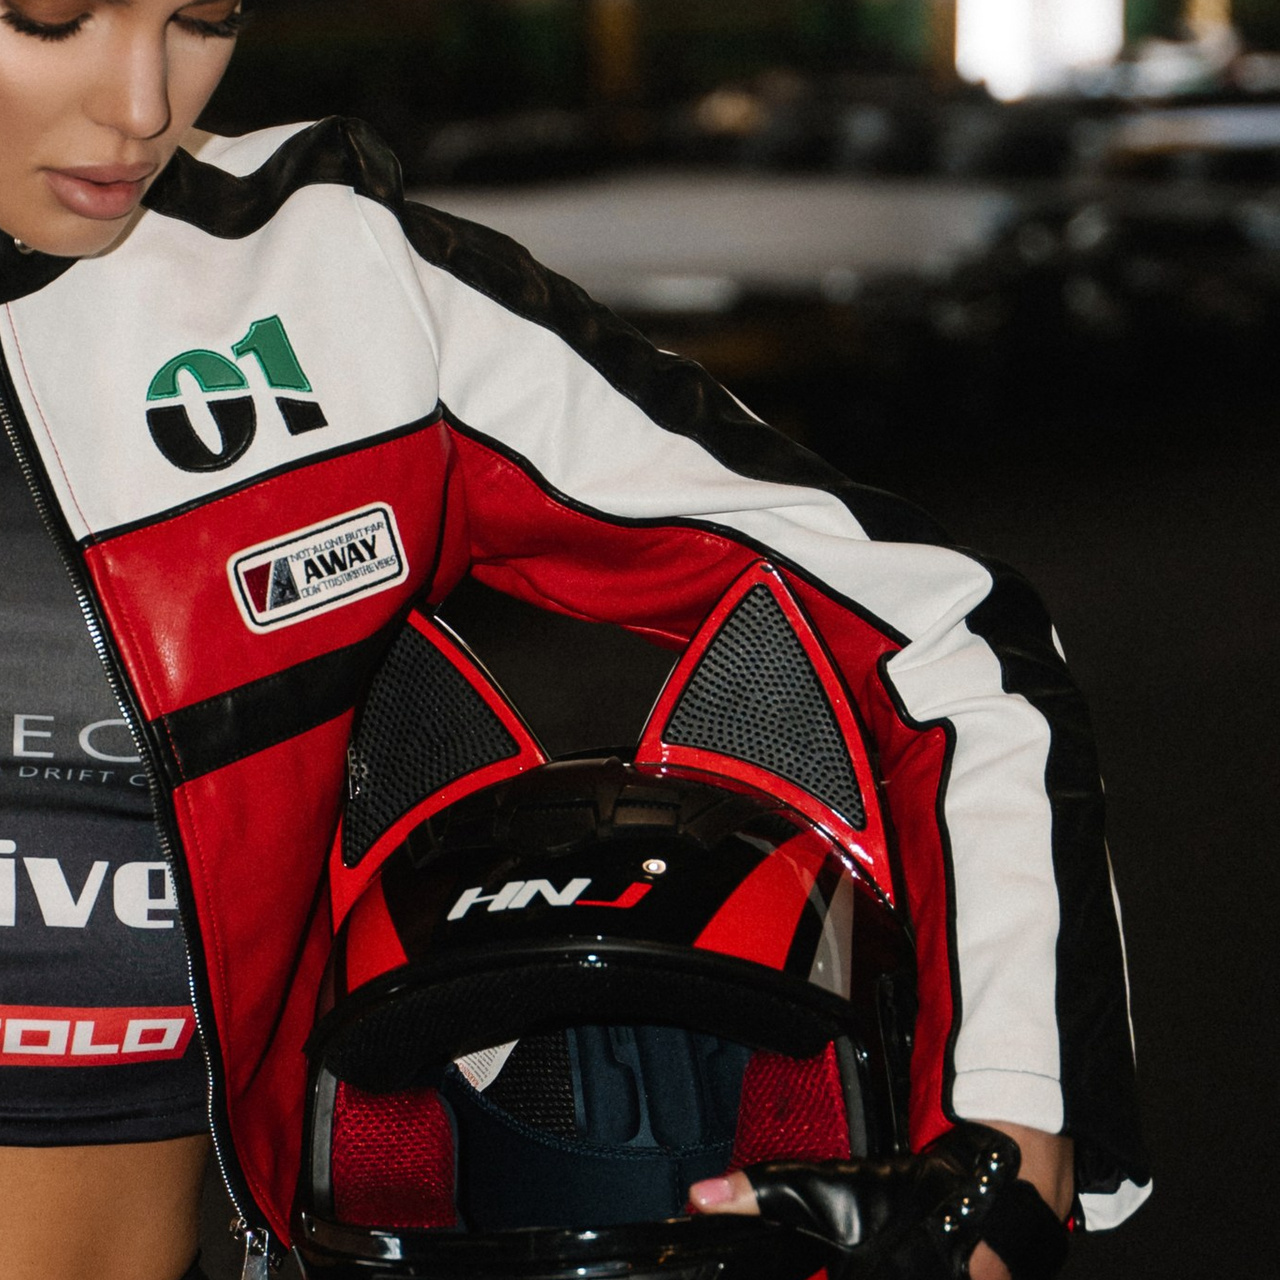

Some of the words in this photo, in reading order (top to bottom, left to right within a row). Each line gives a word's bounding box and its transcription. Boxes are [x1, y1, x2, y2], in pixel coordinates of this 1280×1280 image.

[145, 314, 329, 473] 01
[289, 548, 314, 562] NOT
[312, 535, 345, 555] ALONE
[345, 529, 365, 542] BUT
[363, 521, 384, 535] FAR
[304, 534, 378, 584] AWAY
[19, 766, 115, 784] DRIFT
